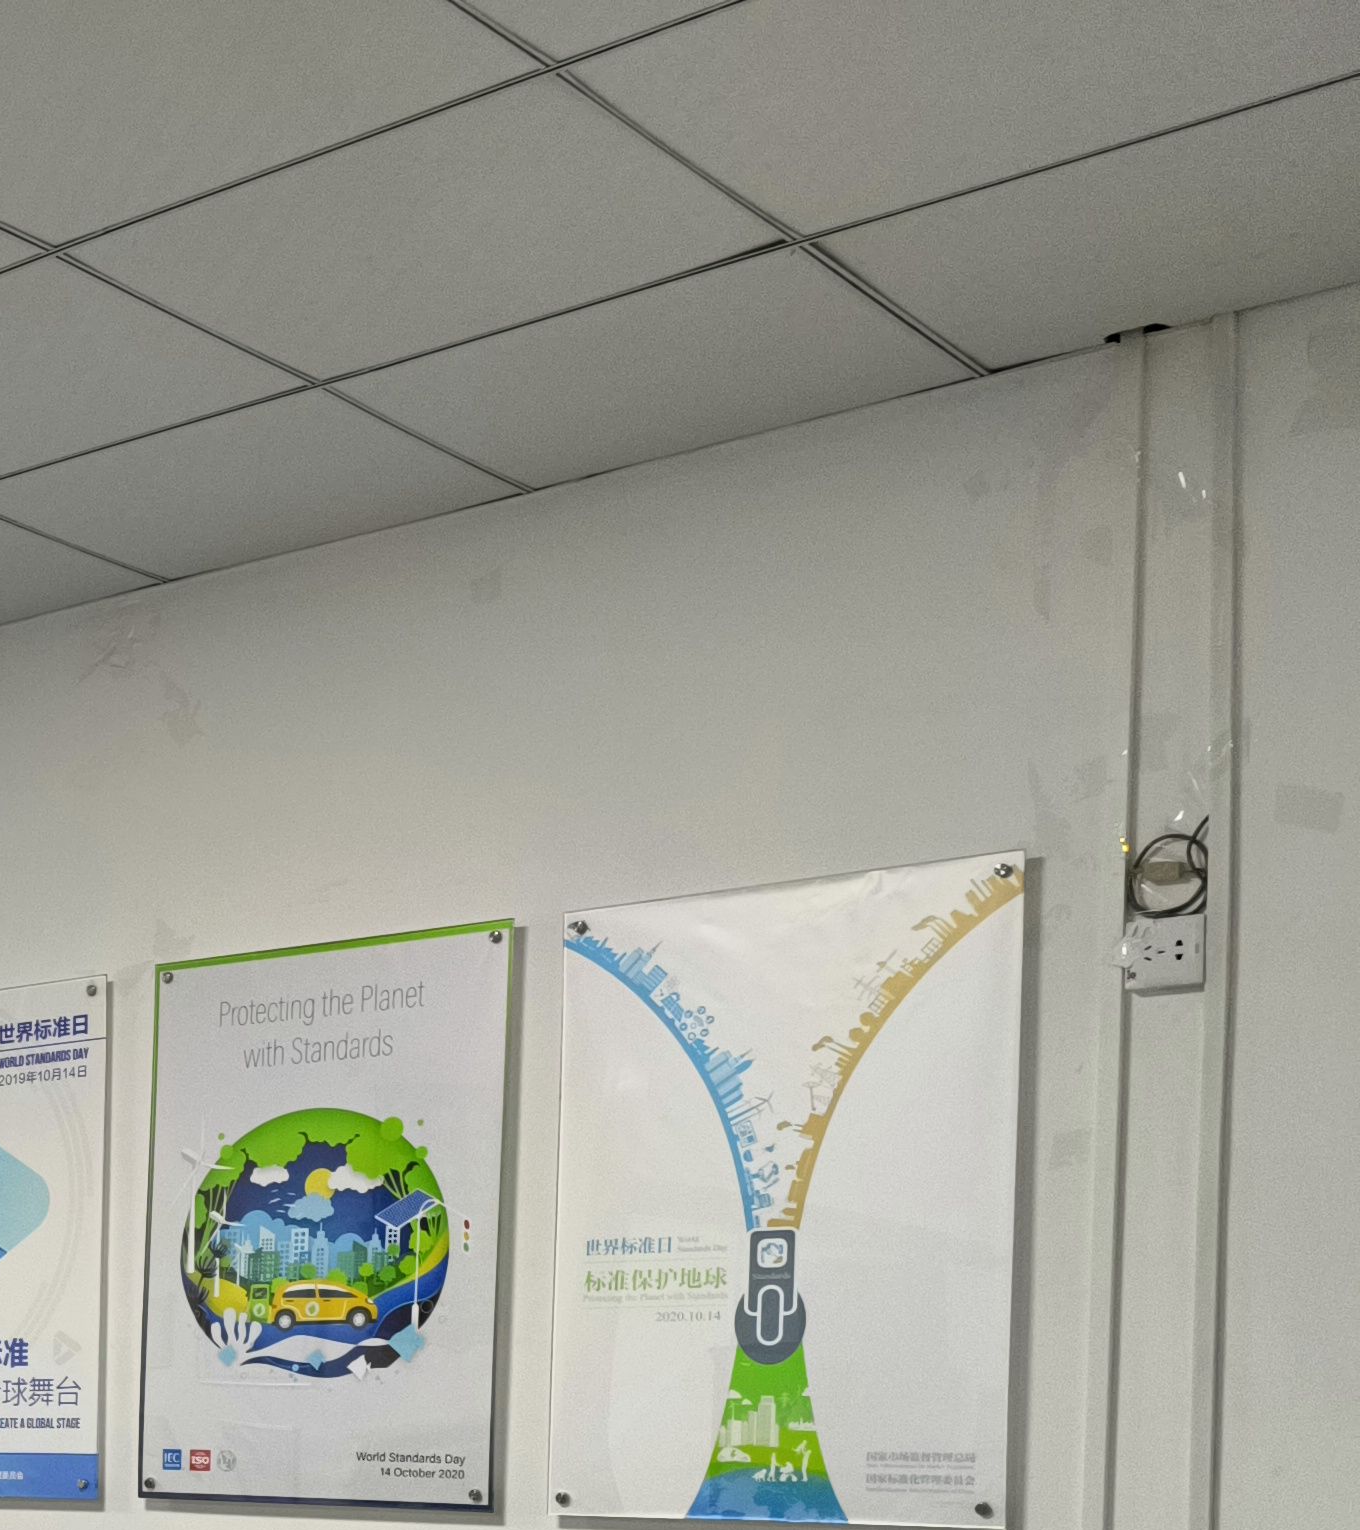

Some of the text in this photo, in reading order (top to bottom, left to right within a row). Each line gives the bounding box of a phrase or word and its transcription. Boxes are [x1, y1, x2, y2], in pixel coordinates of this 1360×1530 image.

[219, 981, 425, 1027] Protecting the Planet
[244, 1028, 394, 1069] with Standards
[25, 1049, 72, 1066] STANDARDS
[72, 1047, 89, 1060] DAY
[586, 1236, 672, 1256] 世界标准日
[584, 1266, 727, 1292] 标准保护地球
[655, 1311, 721, 1322] 2020.10.14
[19, 1417, 25, 1429] A
[26, 1417, 54, 1429] GLOBAL
[56, 1417, 81, 1429] STAGE
[164, 1452, 180, 1463] IEC
[191, 1455, 210, 1465] ISO
[356, 1452, 466, 1467] World Standards Day
[380, 1467, 465, 1480] 14 October 2020
